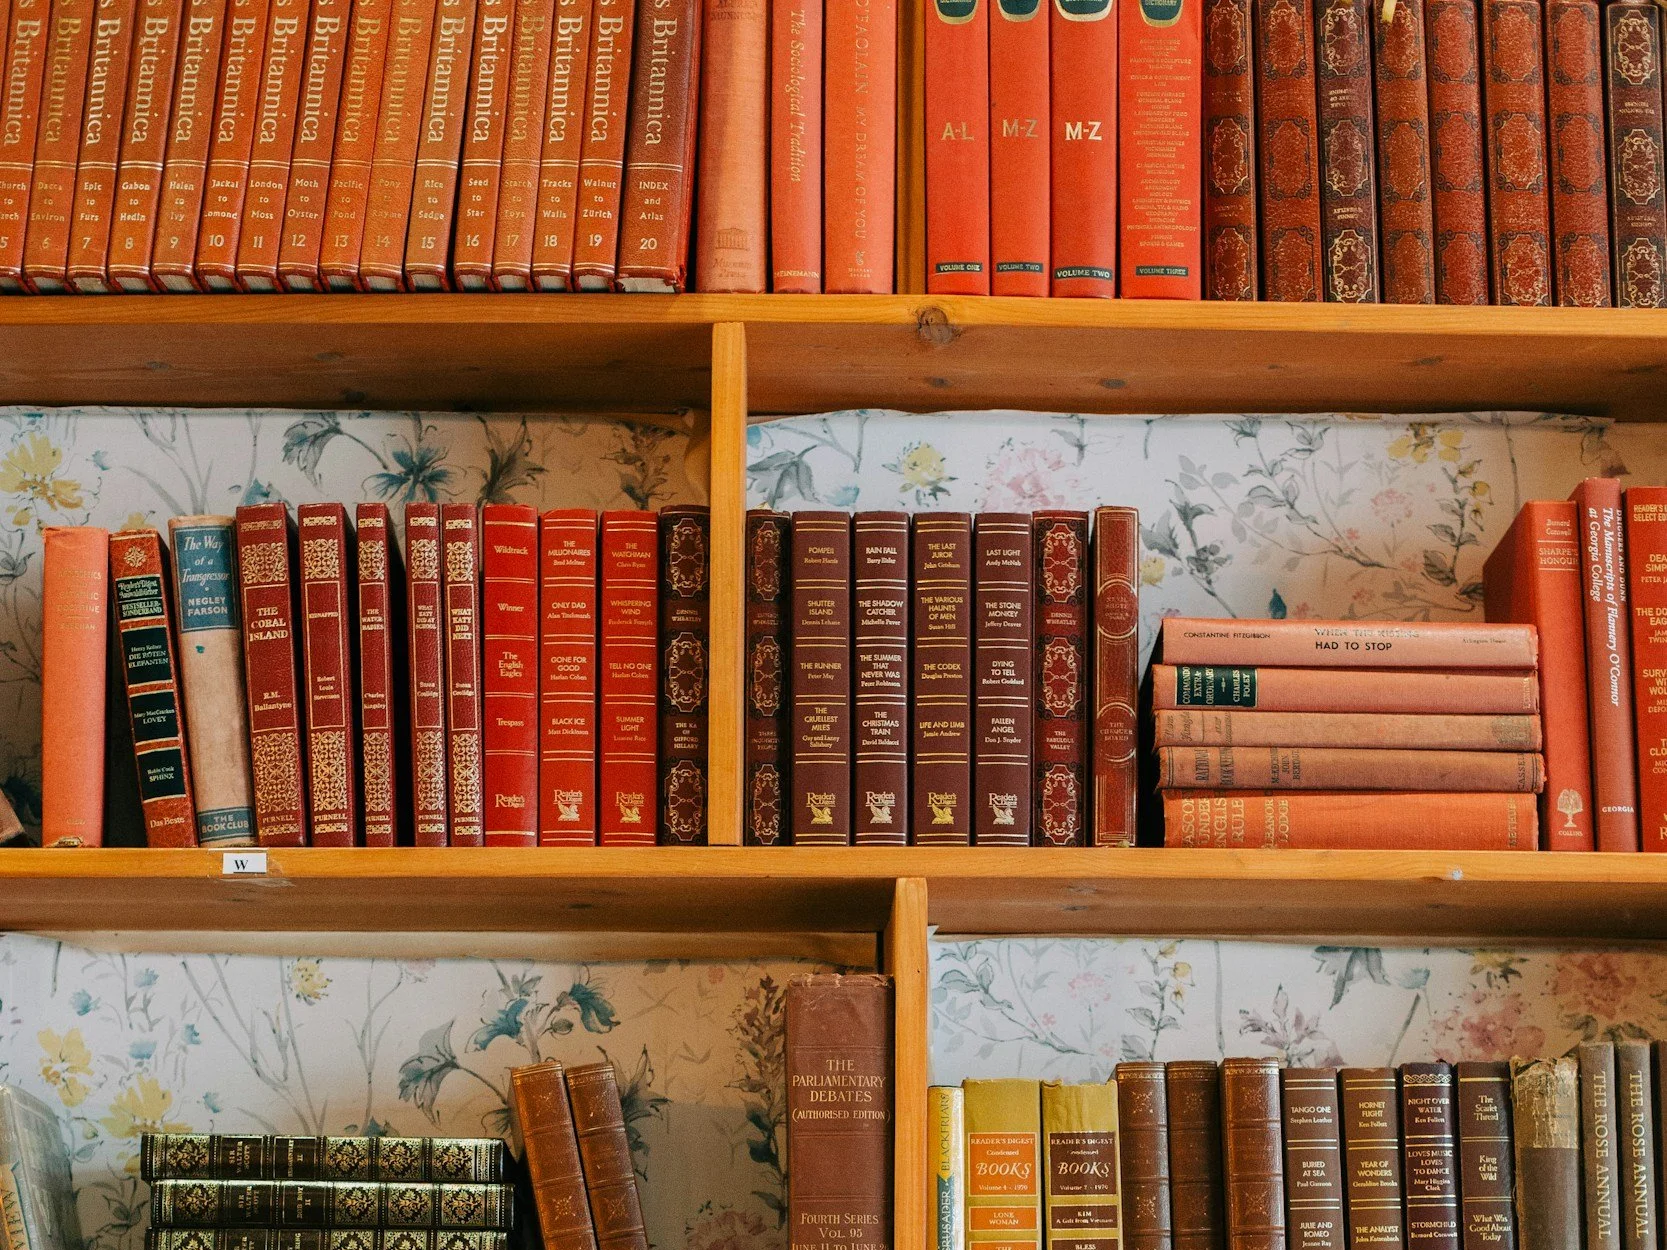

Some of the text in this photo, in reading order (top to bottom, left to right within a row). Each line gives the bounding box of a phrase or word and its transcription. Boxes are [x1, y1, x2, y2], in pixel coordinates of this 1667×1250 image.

[791, 11, 806, 39] The
[86, 16, 122, 145] Britannica
[473, 14, 509, 144] Britannica
[589, 15, 624, 144] Britannica
[645, 17, 678, 145] Britannica
[789, 42, 807, 116] Sociological
[941, 121, 974, 142] A-L
[1002, 118, 1039, 139] M-Z
[1064, 121, 1103, 141] M-Z
[250, 180, 283, 190] London
[295, 179, 319, 188] Moth
[583, 178, 616, 188] Walnut
[639, 181, 668, 190] INDEX
[259, 196, 269, 204] to
[300, 195, 310, 203] to
[594, 195, 603, 203] to
[644, 197, 661, 205] and
[251, 211, 274, 220] Moss
[287, 209, 319, 220] Oyster
[639, 211, 664, 221] Atlas
[253, 237, 263, 248] 11
[291, 235, 306, 247] 12
[589, 235, 602, 246] 19
[639, 238, 657, 249] 20
[939, 264, 981, 272] VOLUME ONE
[1057, 268, 1110, 279] VOLUME TWO
[184, 537, 224, 553] The Way
[1588, 507, 1602, 602] at Georgia College
[195, 556, 206, 566] of
[183, 568, 230, 585] Transgressor
[188, 596, 226, 606] NEGLEY
[552, 602, 570, 610] ONLY
[807, 600, 835, 608] SHUTTER
[873, 600, 904, 608] SHADOW
[187, 606, 228, 617] FARSON
[256, 607, 279, 616] THE
[809, 608, 833, 616] ISLAND
[866, 608, 896, 616] CATCHER
[1602, 507, 1621, 707] The Manuscripts of Flannery O'Connor
[251, 618, 286, 629] CORAL
[250, 629, 288, 641] ISLAND
[1183, 631, 1229, 639] CONSTANTINE
[1315, 641, 1392, 651] HAD TO STOP
[801, 662, 842, 670] THE RUNNER
[143, 716, 167, 725] LOVEY
[991, 717, 1015, 725] FALLEN
[149, 773, 174, 783] SPHINX
[213, 815, 234, 823] THE
[202, 820, 249, 833] BOOK CLUB
[234, 859, 248, 870] W
[826, 1059, 855, 1071] THE
[793, 1075, 886, 1089] PARLIAMENTARY
[810, 1090, 872, 1103] DEBATES
[792, 1107, 890, 1122] (AUTHORISED EDITION)
[1290, 1106, 1316, 1114] TANGO
[1593, 1071, 1611, 1239] THE ROSE ANNUAL
[976, 1162, 1031, 1178] BOOKS
[1058, 1162, 1111, 1178] BOOKS
[801, 1213, 879, 1225] FOURTH SERIES
